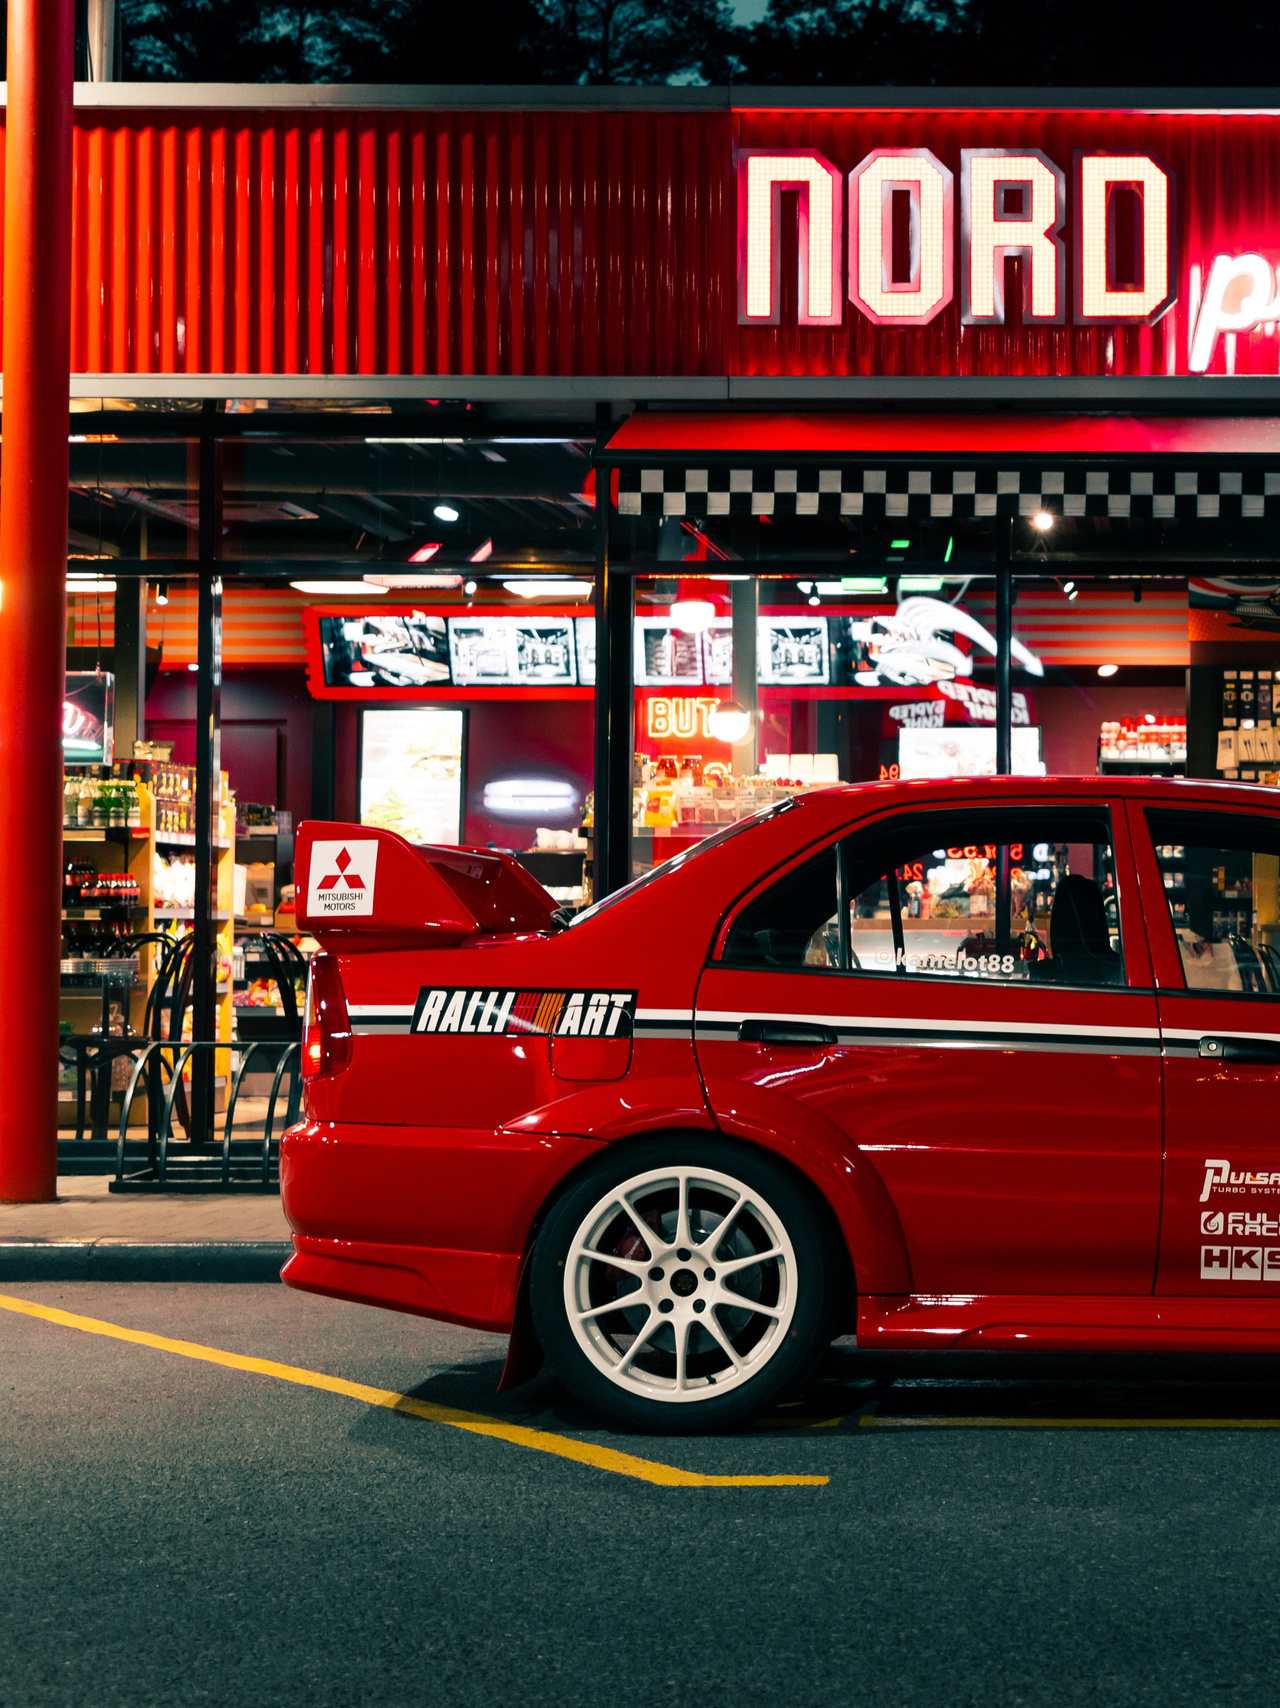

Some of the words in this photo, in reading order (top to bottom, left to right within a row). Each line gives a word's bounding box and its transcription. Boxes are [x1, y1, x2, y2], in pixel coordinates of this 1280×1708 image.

[738, 148, 1177, 325] NORD
[318, 893, 363, 901] MITSUBISHI
[324, 902, 356, 911] MOTORS
